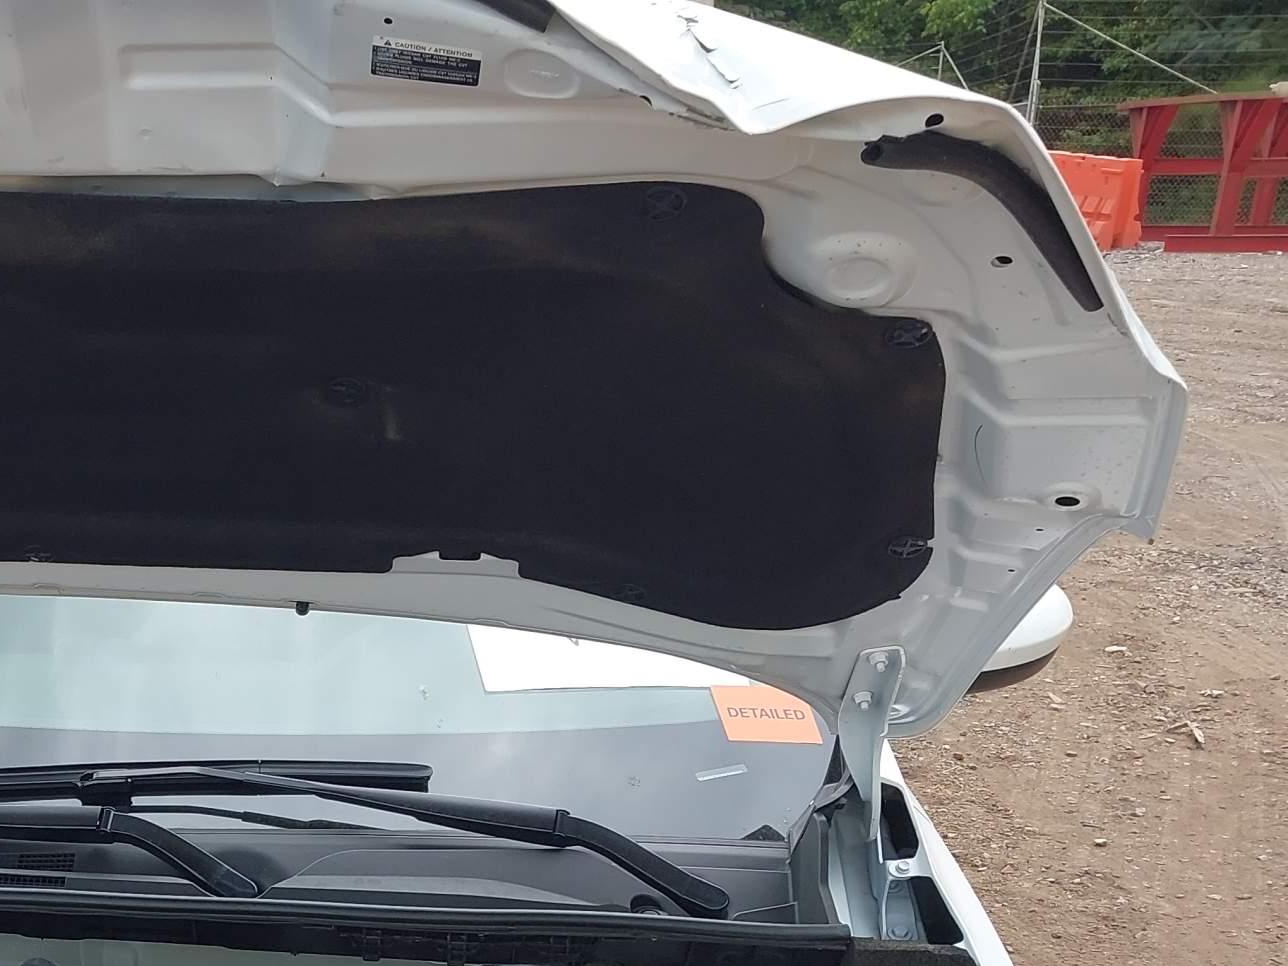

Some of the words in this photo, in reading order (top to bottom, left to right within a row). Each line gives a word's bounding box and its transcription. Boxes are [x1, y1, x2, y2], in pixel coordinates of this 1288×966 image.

[395, 41, 426, 51] CAUTION
[433, 46, 473, 58] ATTENTION
[726, 706, 806, 721] DETAILED
